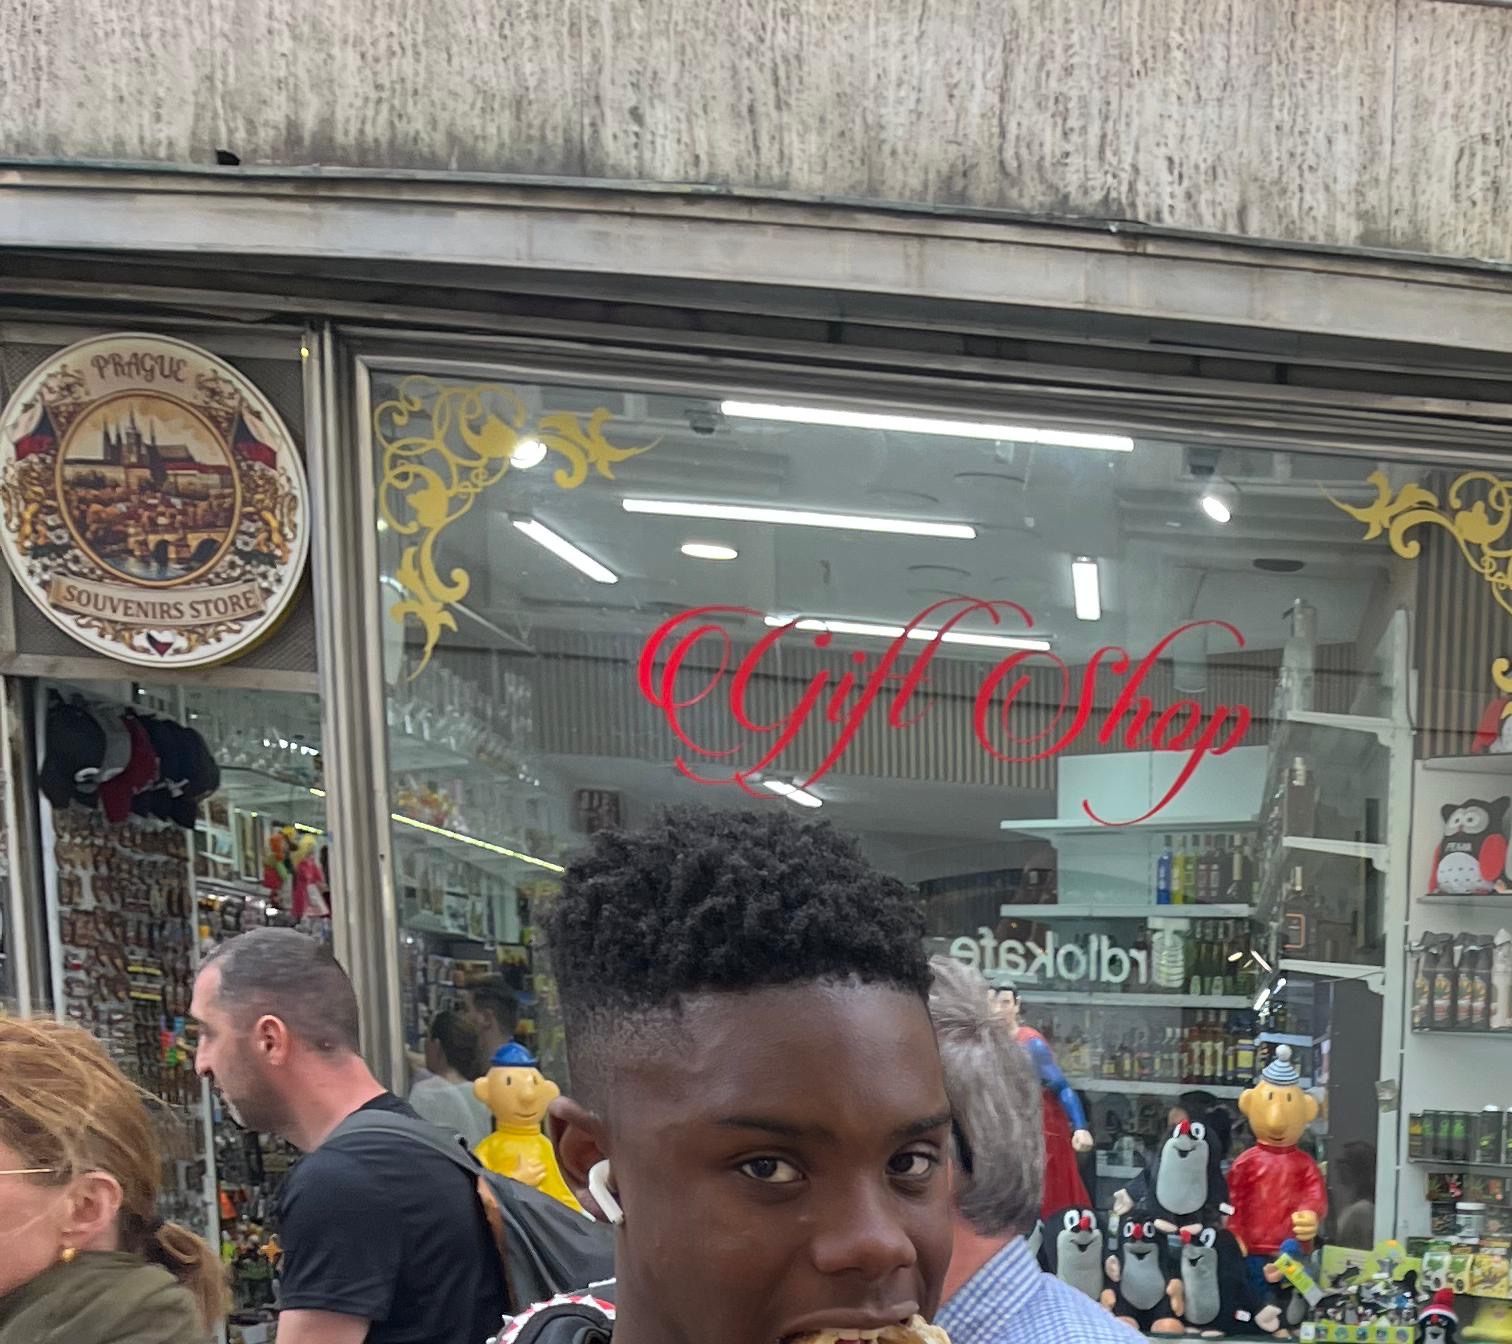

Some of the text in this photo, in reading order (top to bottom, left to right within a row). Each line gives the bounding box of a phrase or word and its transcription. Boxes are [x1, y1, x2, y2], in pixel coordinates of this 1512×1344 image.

[91, 352, 188, 383] PRAGUE
[64, 584, 257, 620] SOUVENIRS STORE
[638, 597, 1246, 827] Gift Shop
